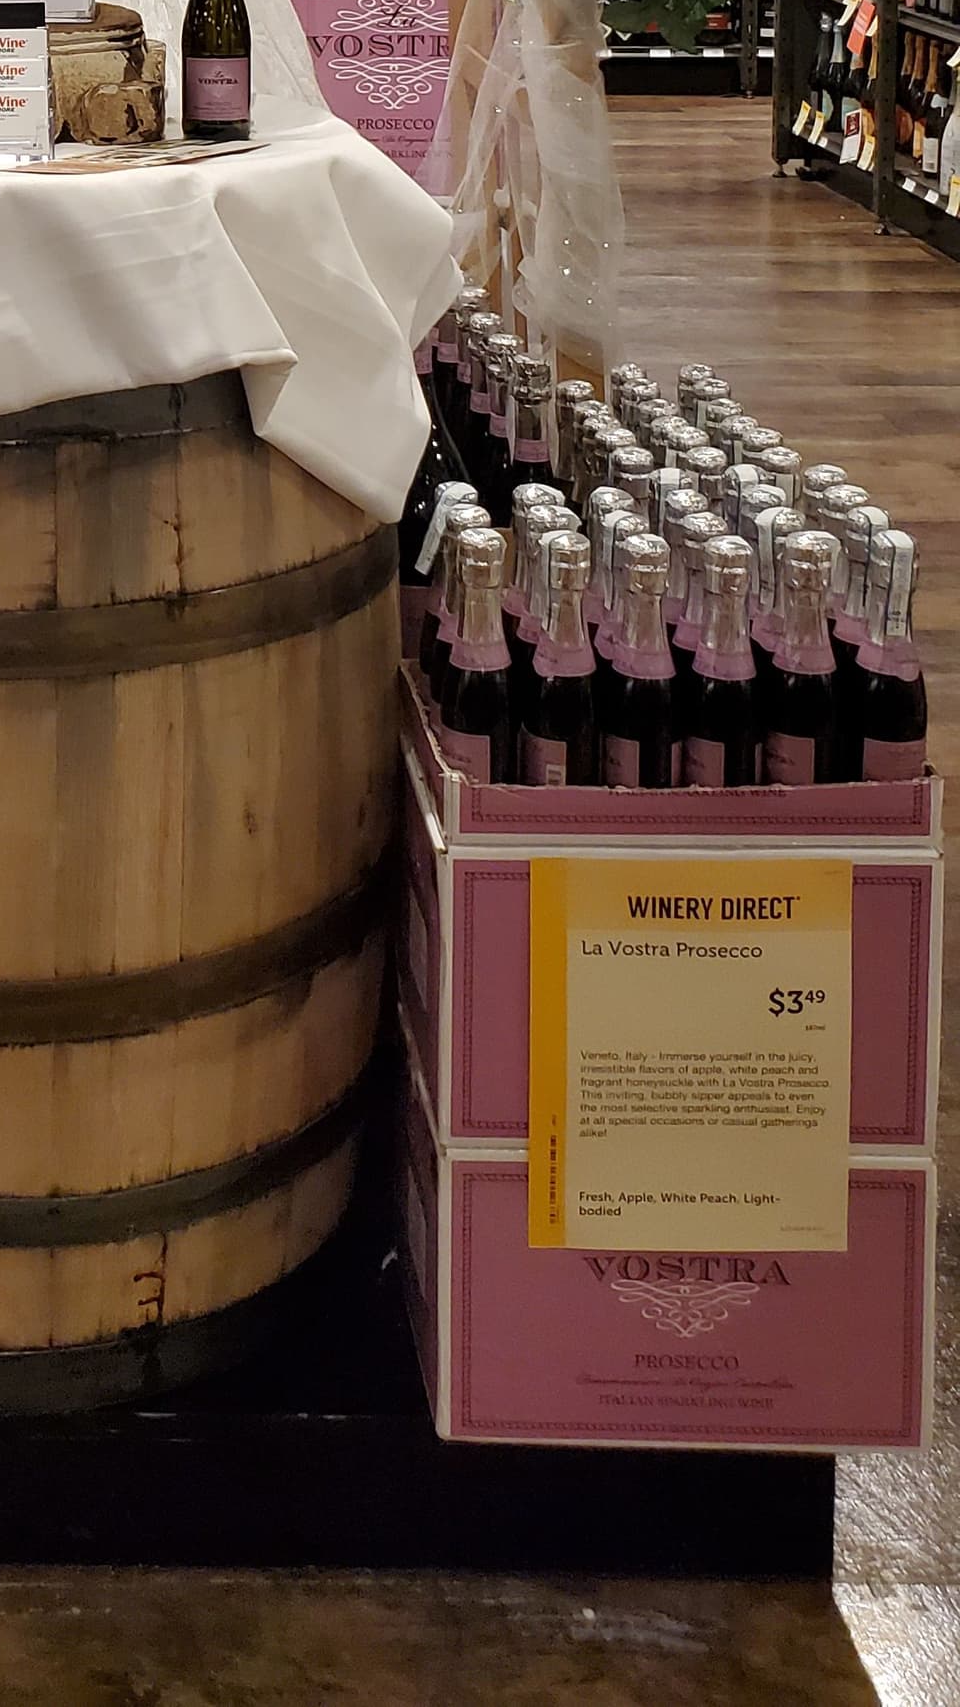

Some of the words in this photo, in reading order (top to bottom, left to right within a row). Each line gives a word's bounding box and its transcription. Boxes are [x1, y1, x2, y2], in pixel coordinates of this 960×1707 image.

[307, 34, 450, 59] VOSTR
[357, 119, 434, 130] PROSECCO
[627, 896, 713, 919] WINERY
[721, 897, 795, 920] DIRECT
[582, 940, 603, 955] La
[608, 941, 670, 957] Vostra
[677, 942, 762, 958] Prosecco
[579, 1192, 613, 1203] Fresh,
[619, 1192, 656, 1204] Apple,
[661, 1193, 696, 1204] White
[700, 1194, 739, 1204] Peach,
[744, 1194, 780, 1206] Light-
[579, 1206, 621, 1216] bodied
[583, 1255, 791, 1285] VOSTRA
[634, 1354, 739, 1370] PROSECCO
